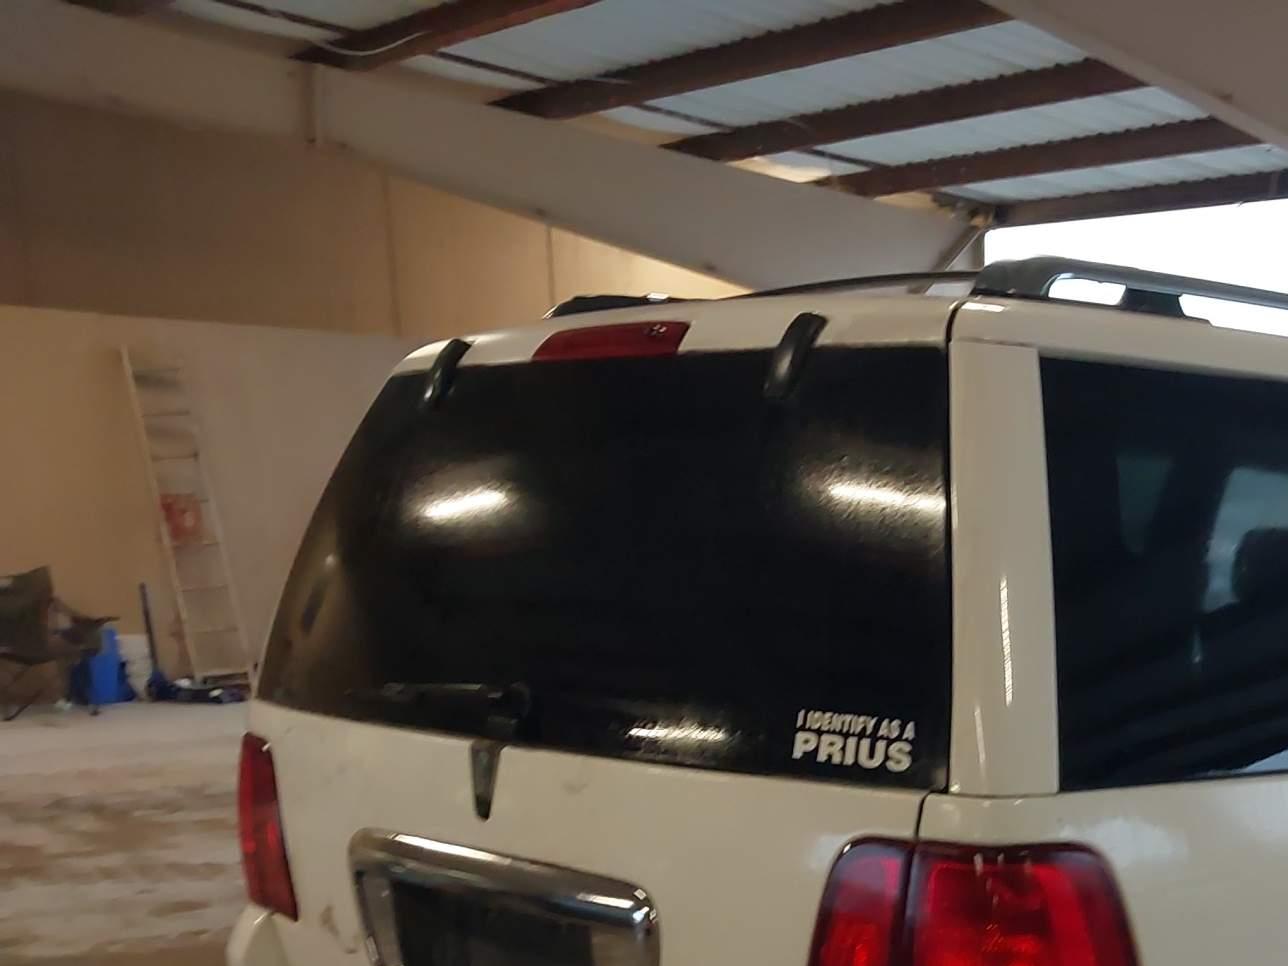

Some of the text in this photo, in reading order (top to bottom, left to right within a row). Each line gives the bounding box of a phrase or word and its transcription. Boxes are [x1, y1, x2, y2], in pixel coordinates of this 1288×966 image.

[796, 709, 916, 740] I IDENTIFY AS A
[792, 731, 913, 773] PRIUS
